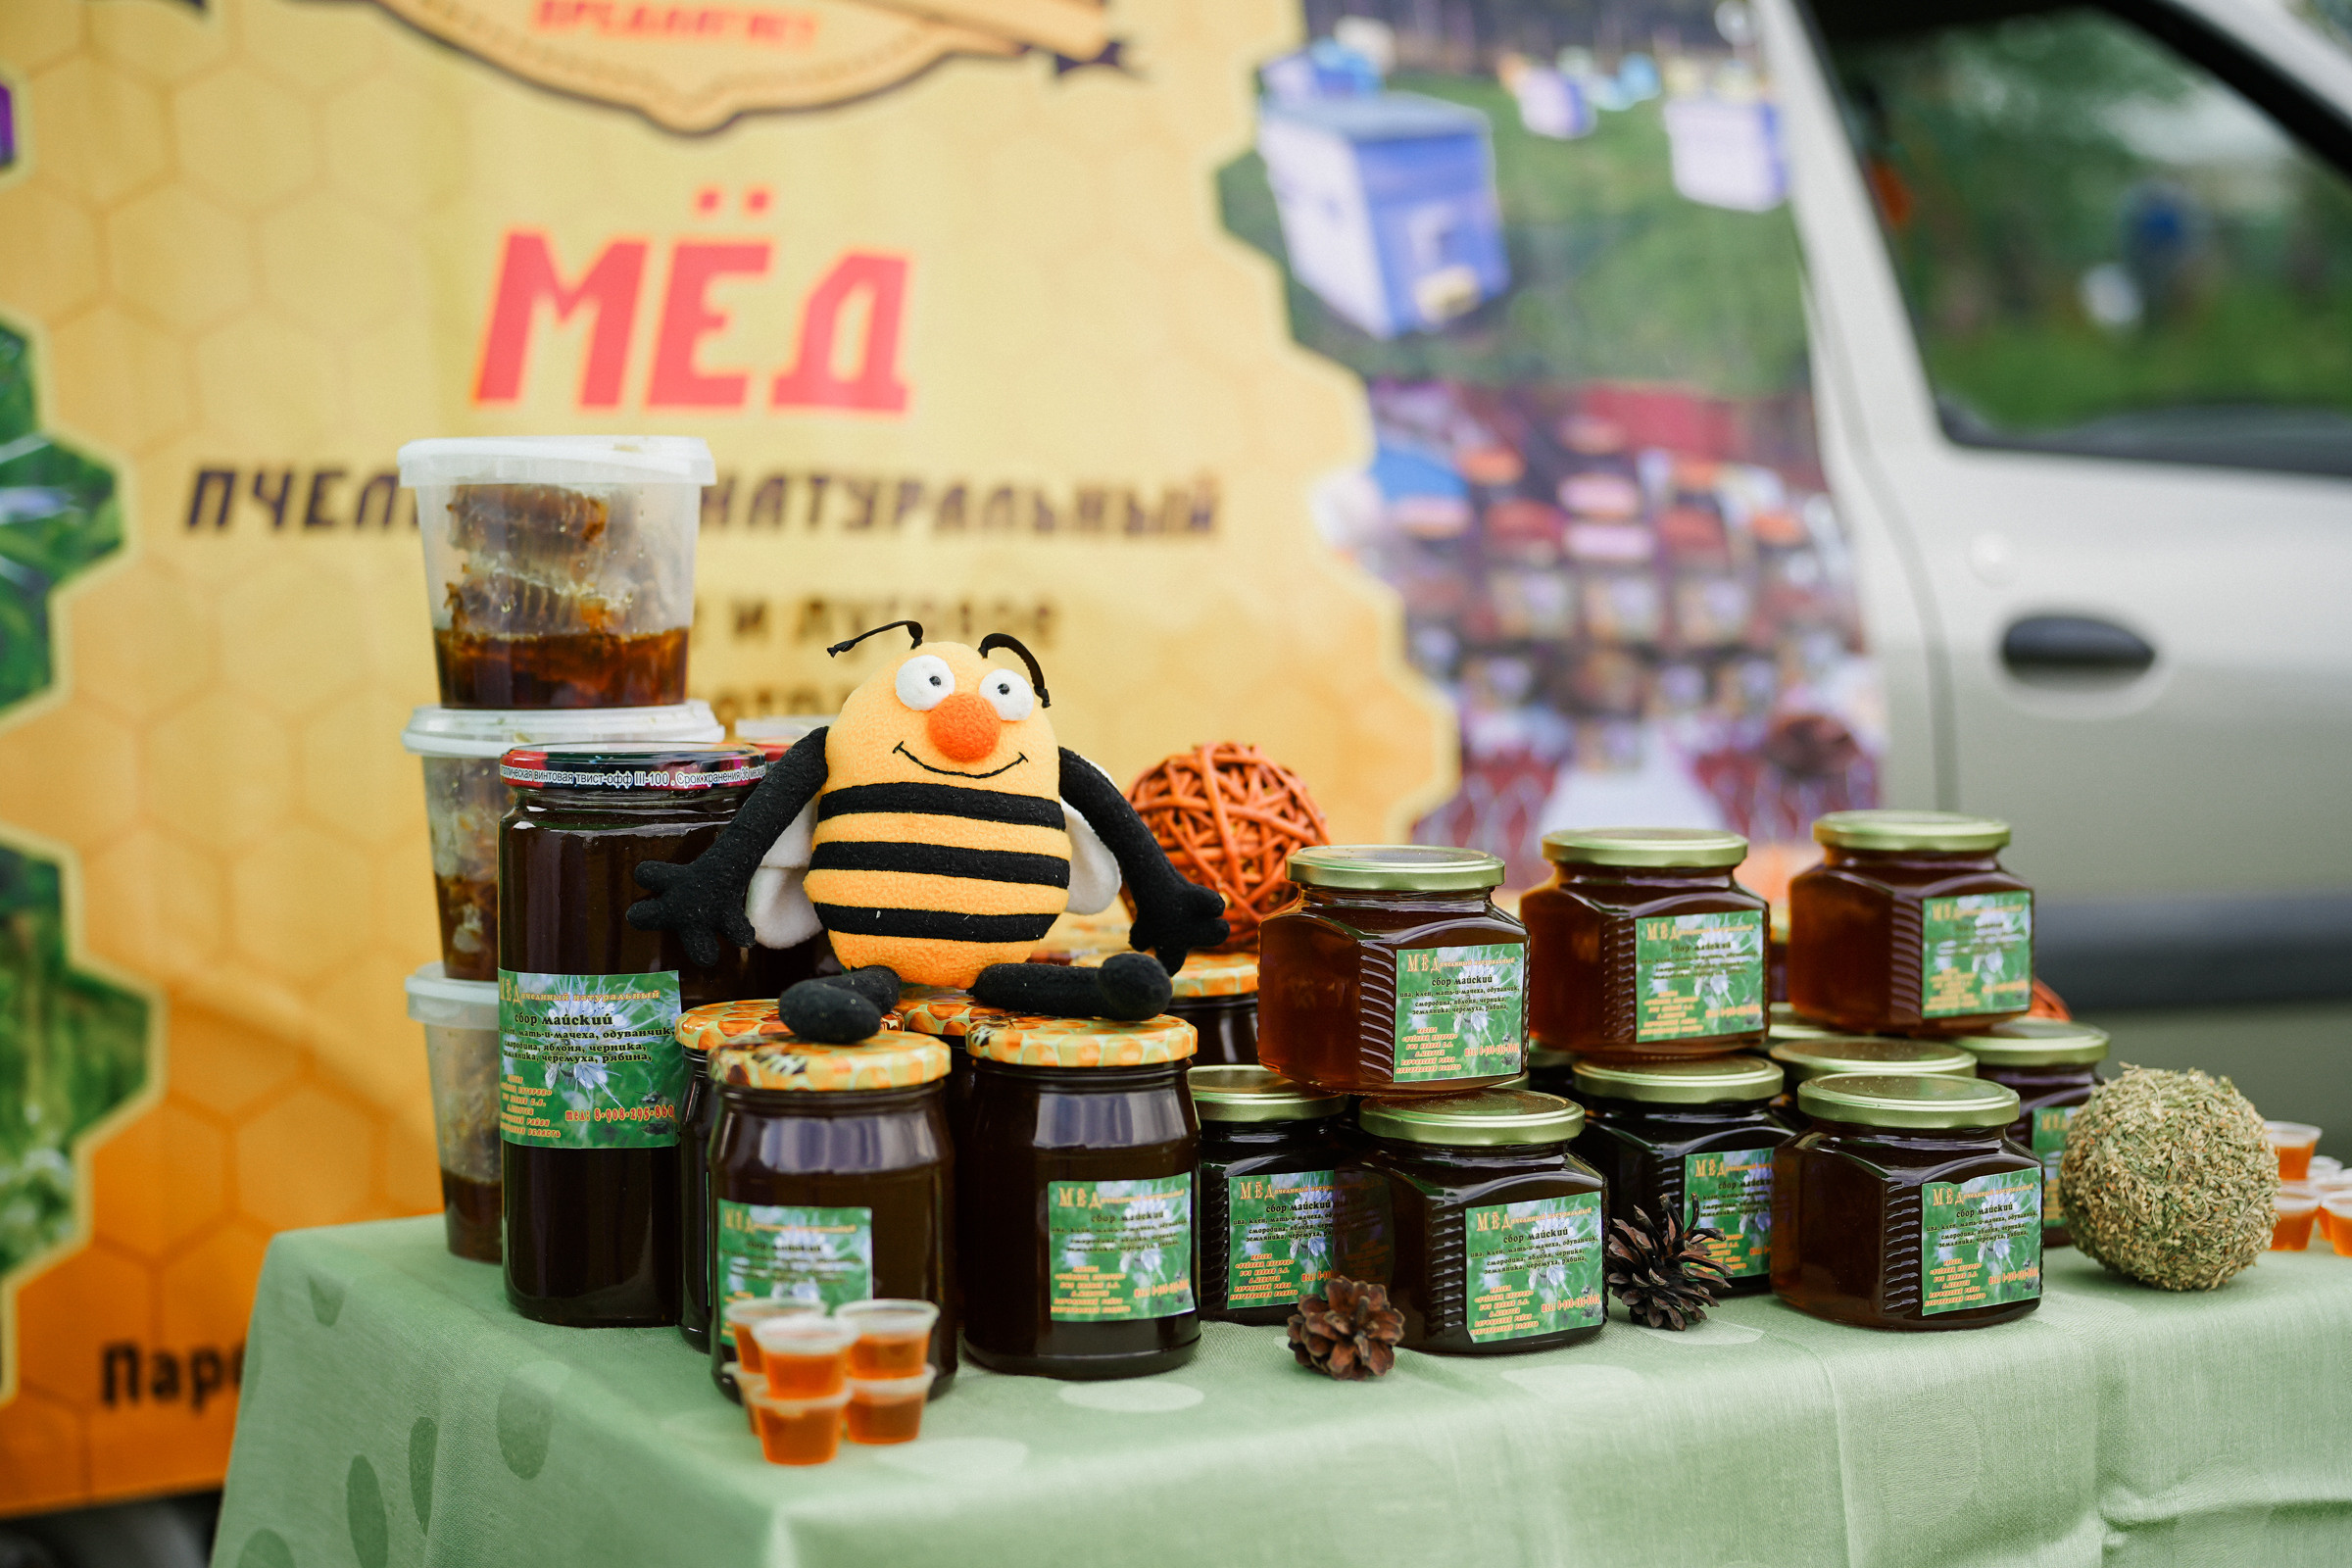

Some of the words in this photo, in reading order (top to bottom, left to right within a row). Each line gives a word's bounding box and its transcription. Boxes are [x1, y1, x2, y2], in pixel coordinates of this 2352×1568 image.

[470, 184, 913, 416] МЁД
[183, 466, 418, 533] ПЧЕЛ
[534, 770, 574, 782] винтовая
[576, 770, 633, 788] твист-офф
[676, 771, 702, 787] Срок
[705, 769, 740, 787] хранения
[741, 766, 749, 779] 36
[1406, 953, 1440, 973] МЁД
[1431, 977, 1451, 986] сбор
[1453, 975, 1493, 984] майский
[573, 990, 661, 1003] натуральный
[514, 1011, 537, 1026] сбор
[541, 1012, 613, 1026] майский
[518, 1030, 600, 1040] мать-и-мачеха,
[603, 1027, 676, 1040] одуванчик,
[543, 1043, 586, 1054] яблоня,
[589, 1042, 647, 1053] черника,
[602, 1052, 653, 1063] рябина,
[593, 1103, 674, 1123] 8-908-295-860
[1239, 1180, 1275, 1200] МЁД
[1266, 1203, 1287, 1213] сбор
[1290, 1200, 1331, 1210] майский
[1956, 1207, 1974, 1218] сбор
[1977, 1202, 2013, 1214] майский
[1091, 1212, 1116, 1223] сбор
[1476, 1210, 1511, 1231] МЁД
[1503, 1233, 1524, 1244] сбор
[1527, 1227, 1568, 1240] майский
